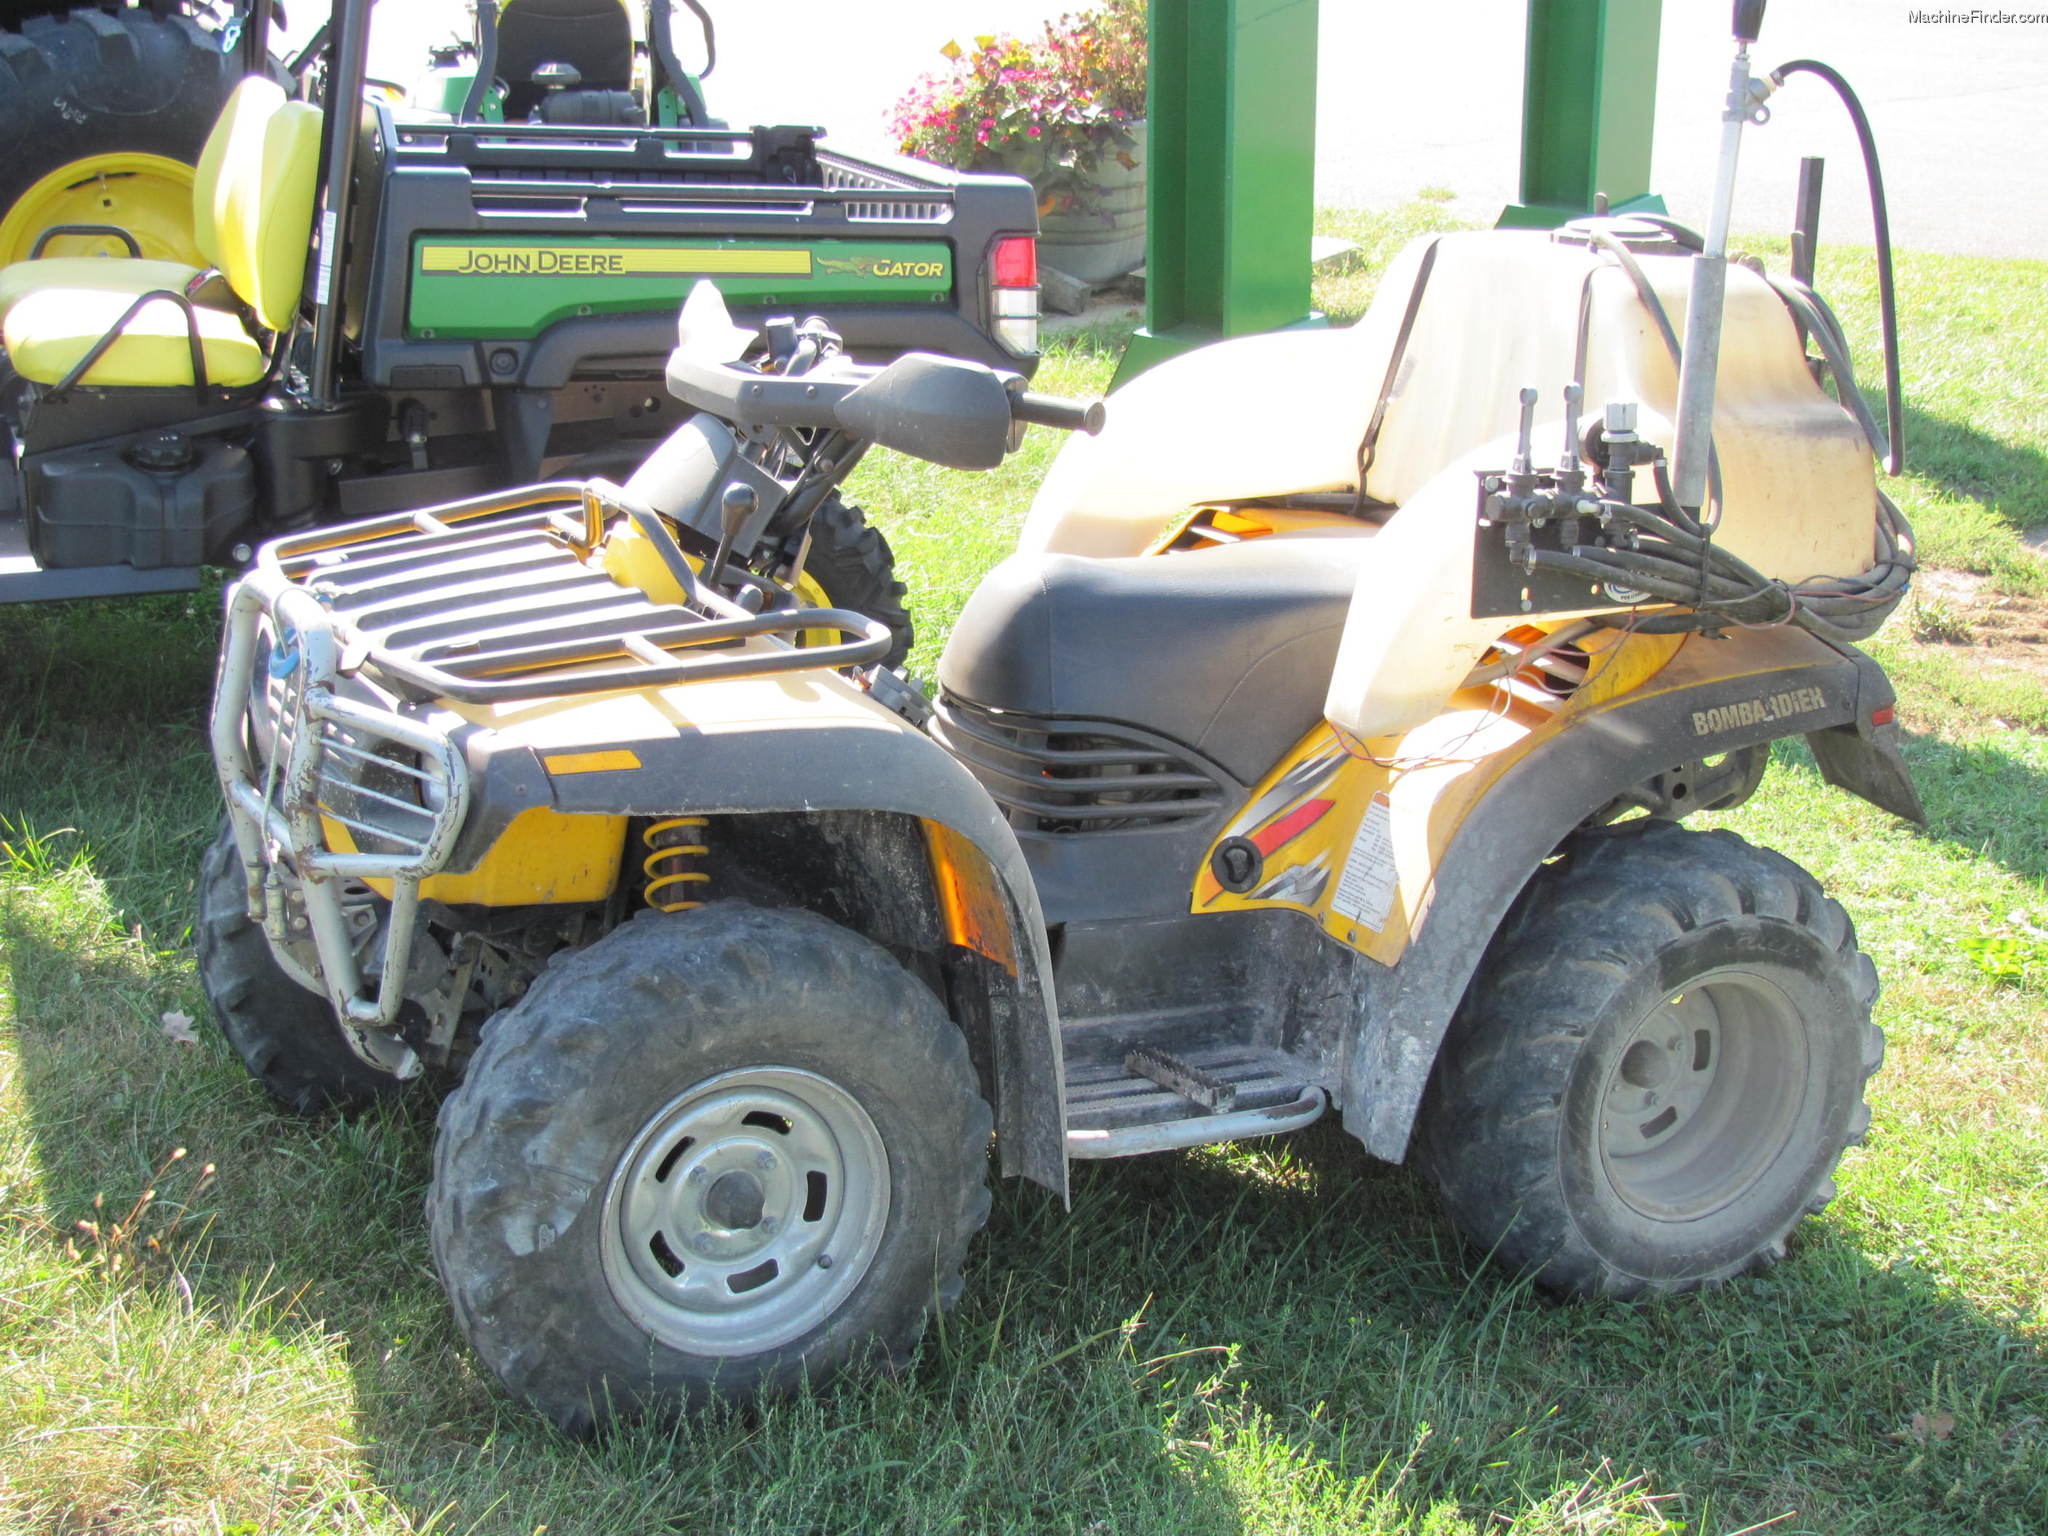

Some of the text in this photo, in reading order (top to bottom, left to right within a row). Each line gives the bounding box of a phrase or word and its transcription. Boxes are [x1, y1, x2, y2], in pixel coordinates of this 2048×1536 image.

[458, 249, 624, 272] JOHN DEERE
[872, 258, 945, 278] GATOR
